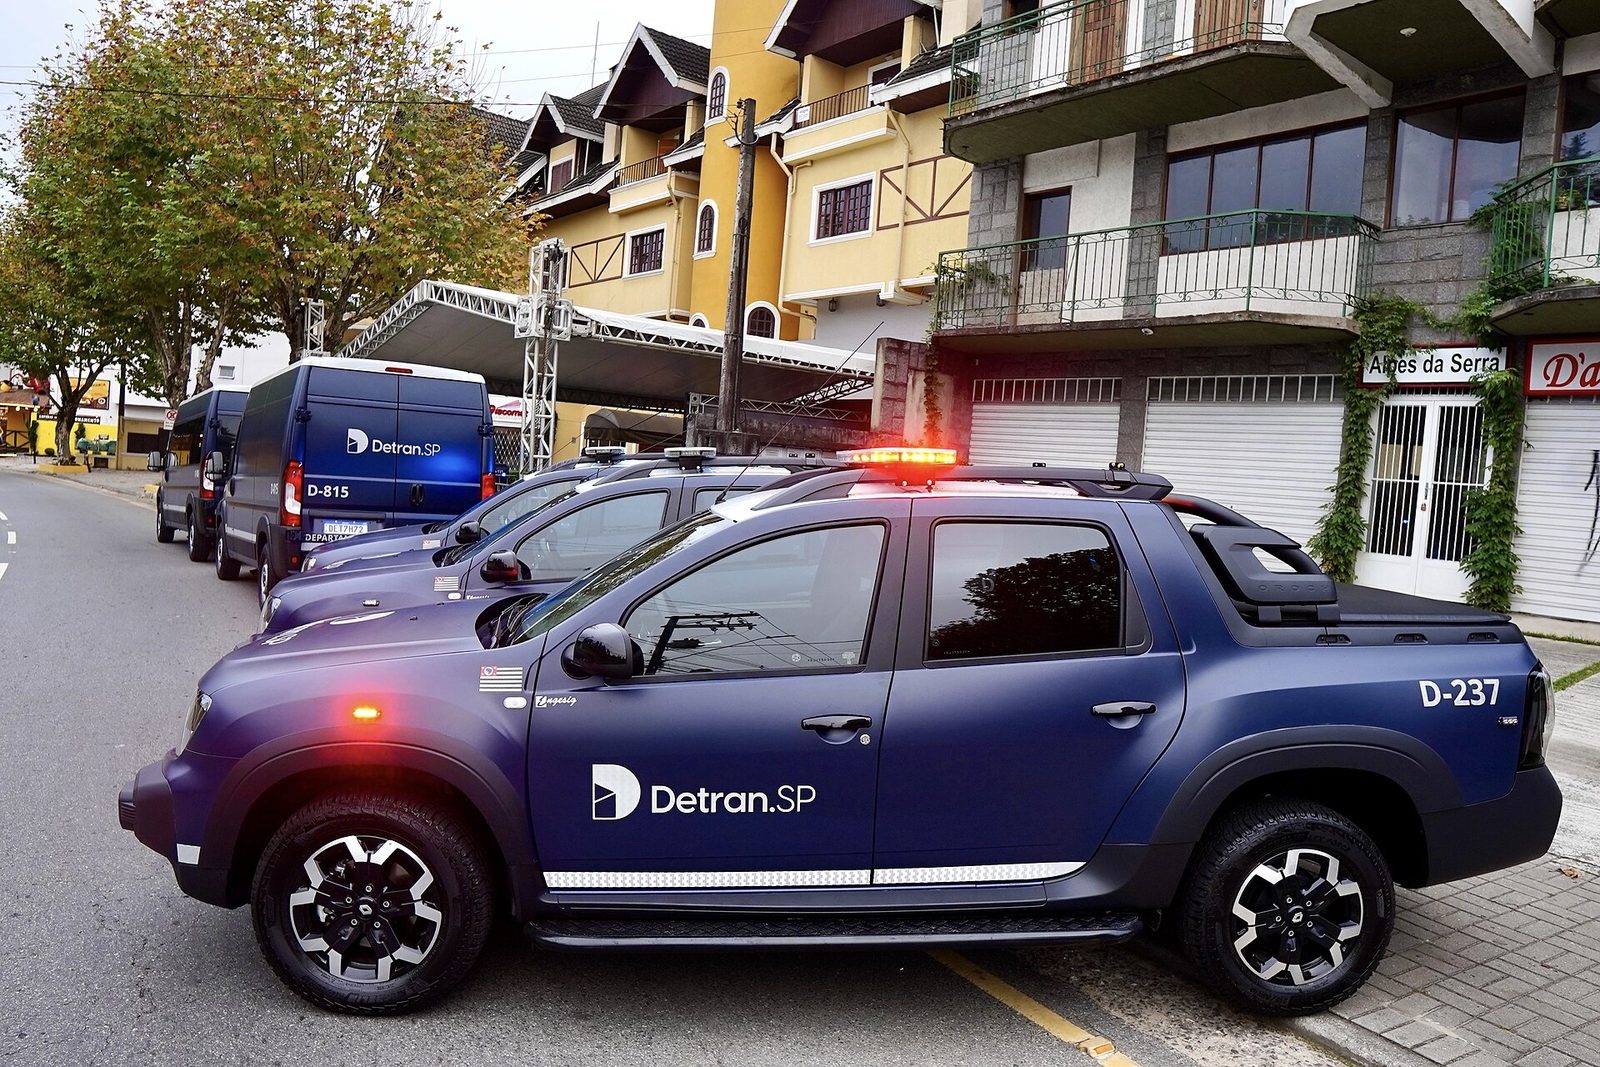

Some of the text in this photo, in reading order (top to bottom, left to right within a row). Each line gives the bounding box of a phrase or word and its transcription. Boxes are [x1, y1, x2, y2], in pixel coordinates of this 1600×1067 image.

[1422, 354, 1444, 373] da
[1450, 353, 1499, 373] Serra
[372, 439, 441, 457] Detran.SP
[307, 484, 349, 499] D-815
[1419, 678, 1500, 708] D-237
[651, 784, 817, 814] Detran.SP
